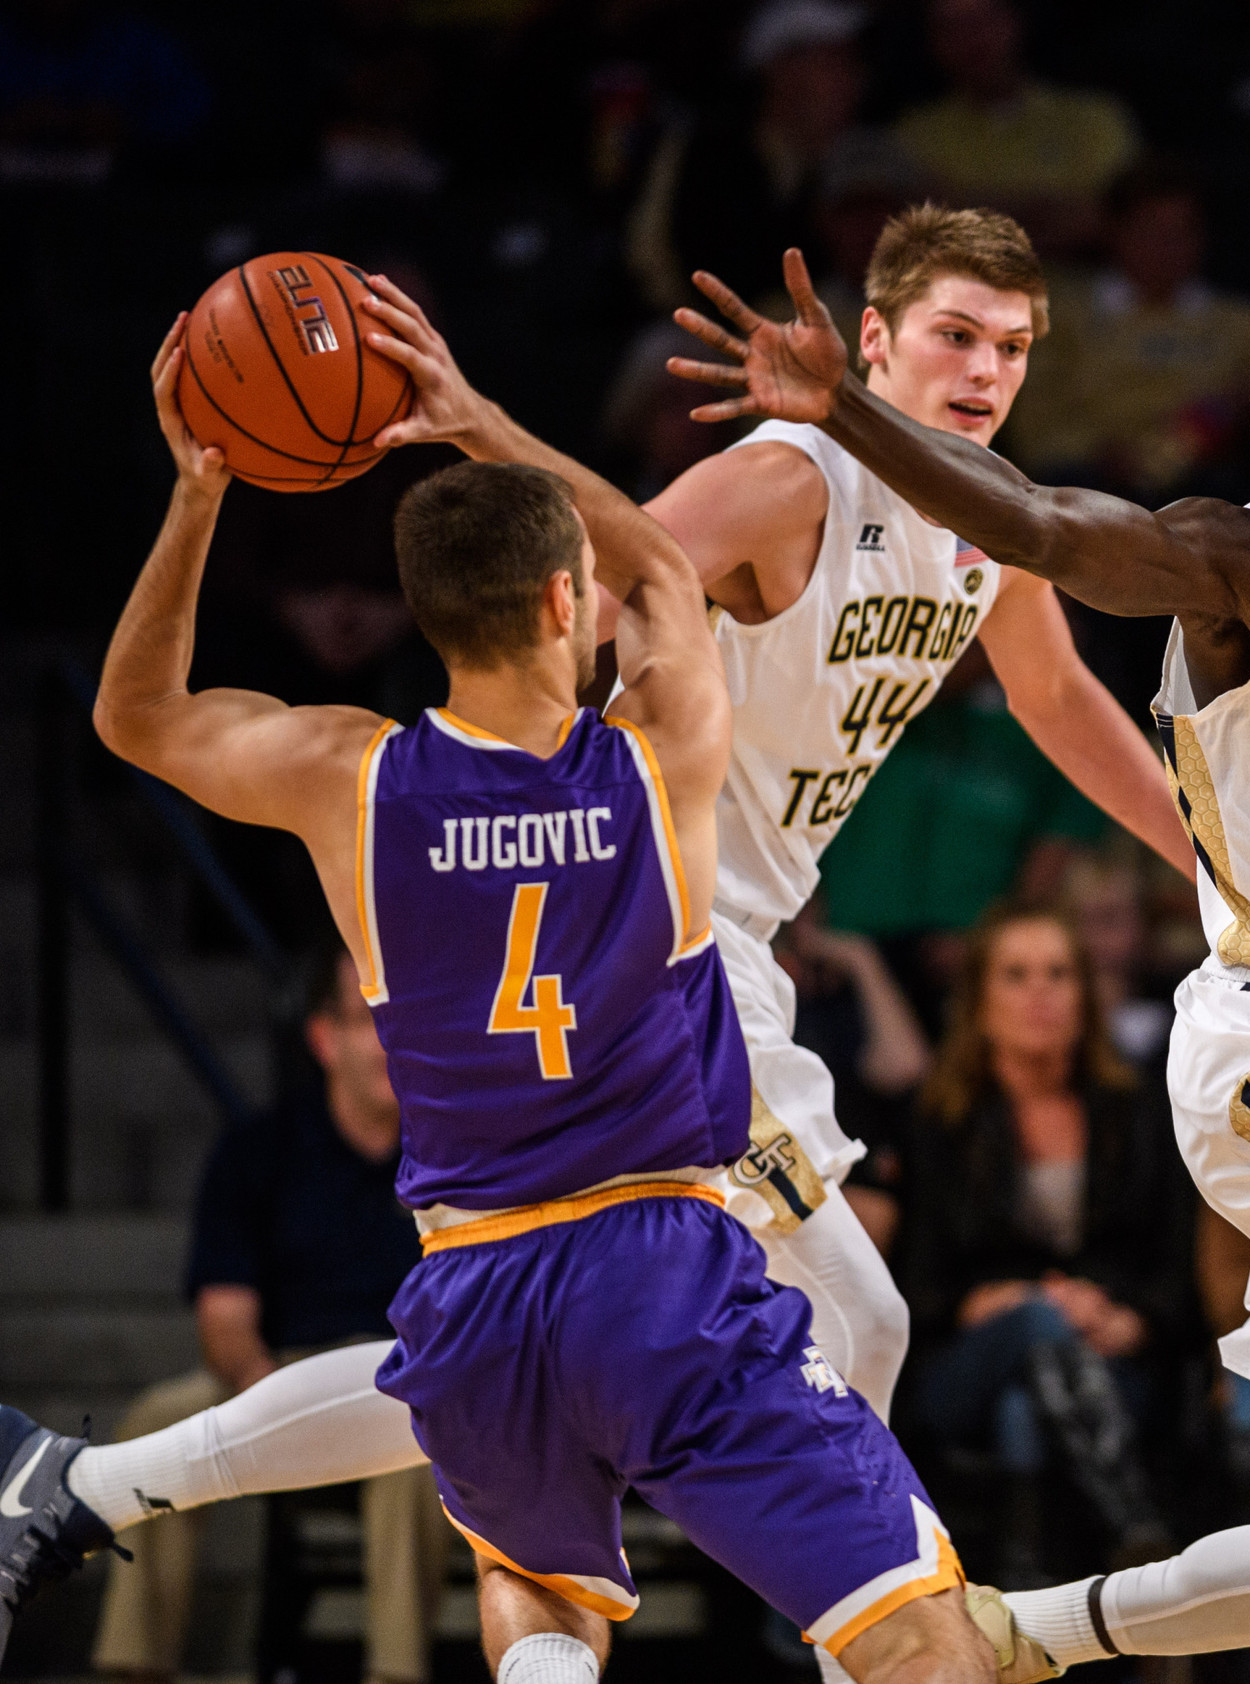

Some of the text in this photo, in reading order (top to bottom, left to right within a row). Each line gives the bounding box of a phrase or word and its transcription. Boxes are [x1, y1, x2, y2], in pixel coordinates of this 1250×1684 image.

[275, 265, 340, 355] ELITE
[840, 675, 930, 757] 44
[428, 807, 617, 872] JUGOVIC
[486, 881, 577, 1081] 4
